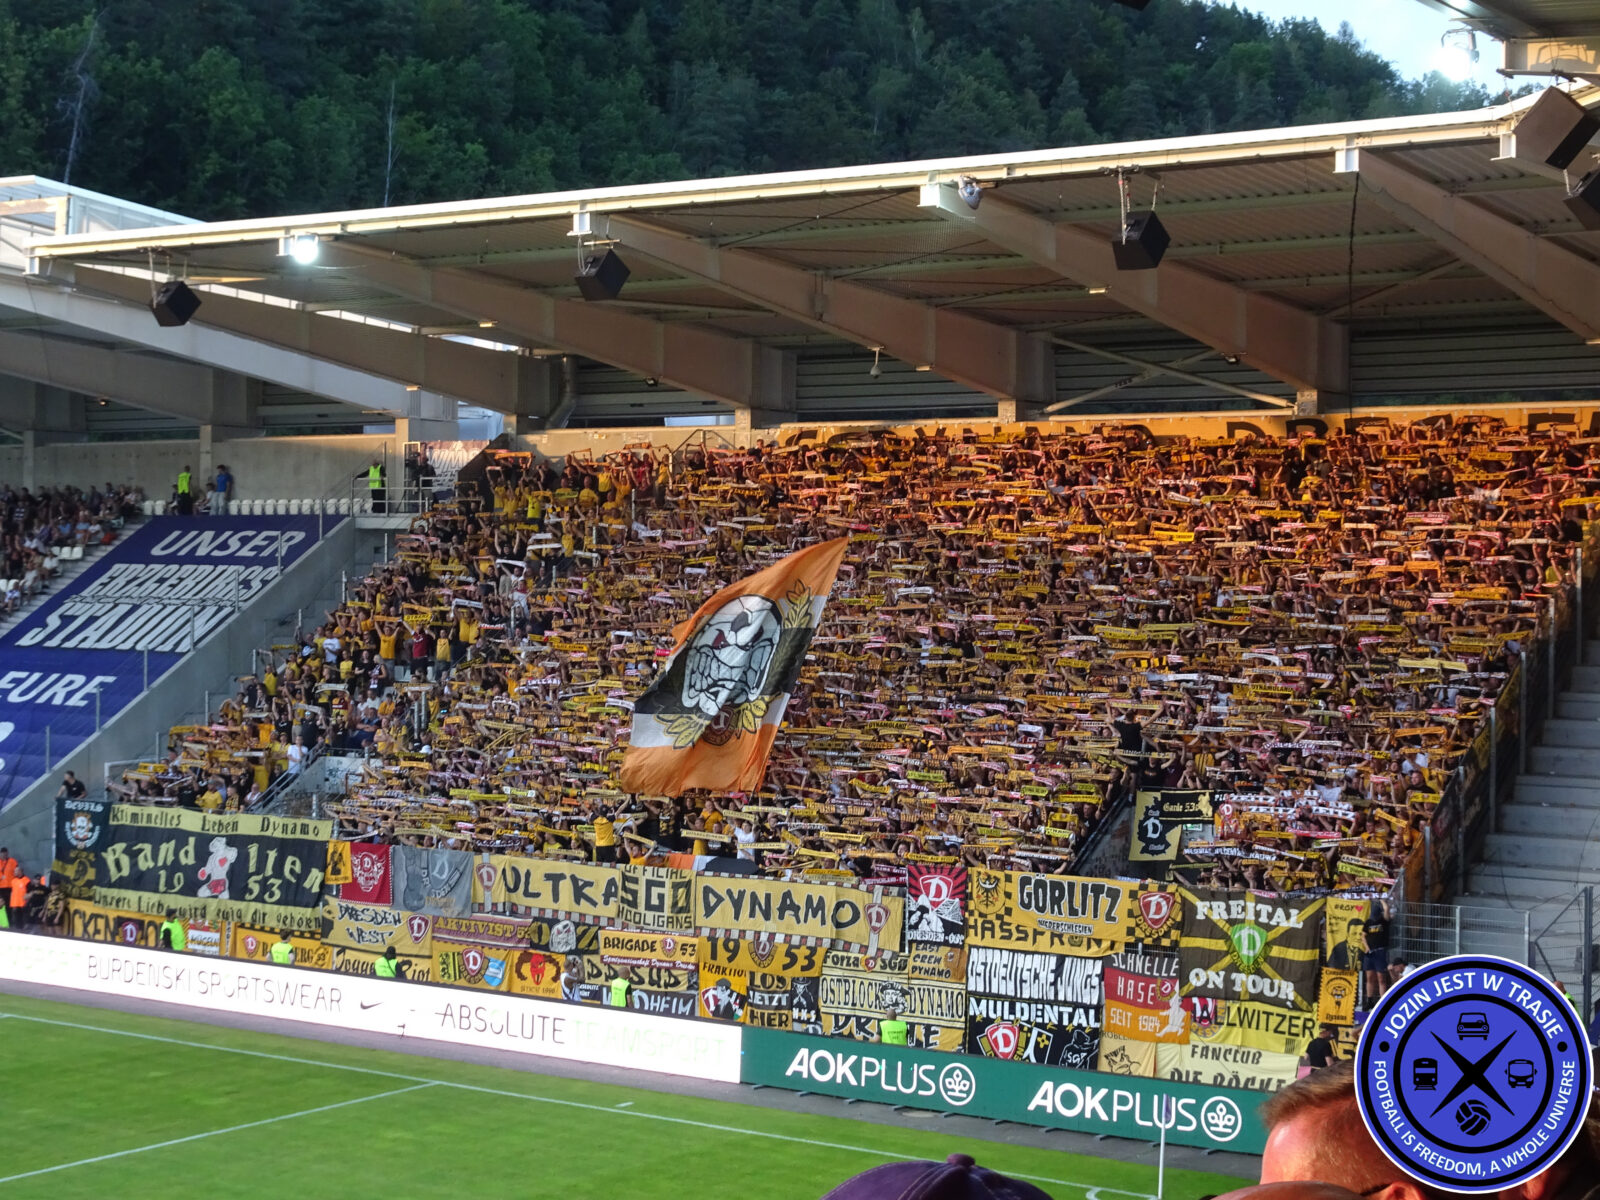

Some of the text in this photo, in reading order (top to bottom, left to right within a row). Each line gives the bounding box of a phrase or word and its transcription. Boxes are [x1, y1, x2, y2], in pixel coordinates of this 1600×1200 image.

[150, 530, 306, 557] UNSER
[0, 671, 117, 707] EURE
[201, 814, 239, 833] Leben
[260, 816, 320, 836] Dynamo
[158, 869, 283, 903] 19 53
[1018, 873, 1122, 924] GÖRLITZ
[337, 902, 403, 927] DRESDEN
[616, 904, 692, 930] HOOLIGANS
[702, 884, 861, 929] DYNAMO
[1195, 899, 1304, 929] FREITAL
[346, 926, 393, 946] WEST
[435, 917, 514, 937] AKTIVIST
[603, 936, 696, 956] BRIGADE 53
[706, 936, 818, 972] 19 53
[702, 961, 747, 978] FRAKTIO
[748, 970, 788, 989] LOS
[911, 964, 951, 979] DYNAMO
[87, 955, 193, 993] BURDENSKI
[197, 969, 342, 1012] SPORTSWEAR
[1117, 975, 1156, 1005] HASE
[1188, 967, 1296, 1001] ON TOUR
[748, 990, 790, 1007] JETZT
[820, 976, 965, 1020] OSTBLOCK DYNAMO
[434, 1001, 567, 1046] ABSOLUTE
[749, 1008, 789, 1028] HIER
[969, 996, 1100, 1029] MULDENTAL
[1110, 1007, 1133, 1028] SEIT
